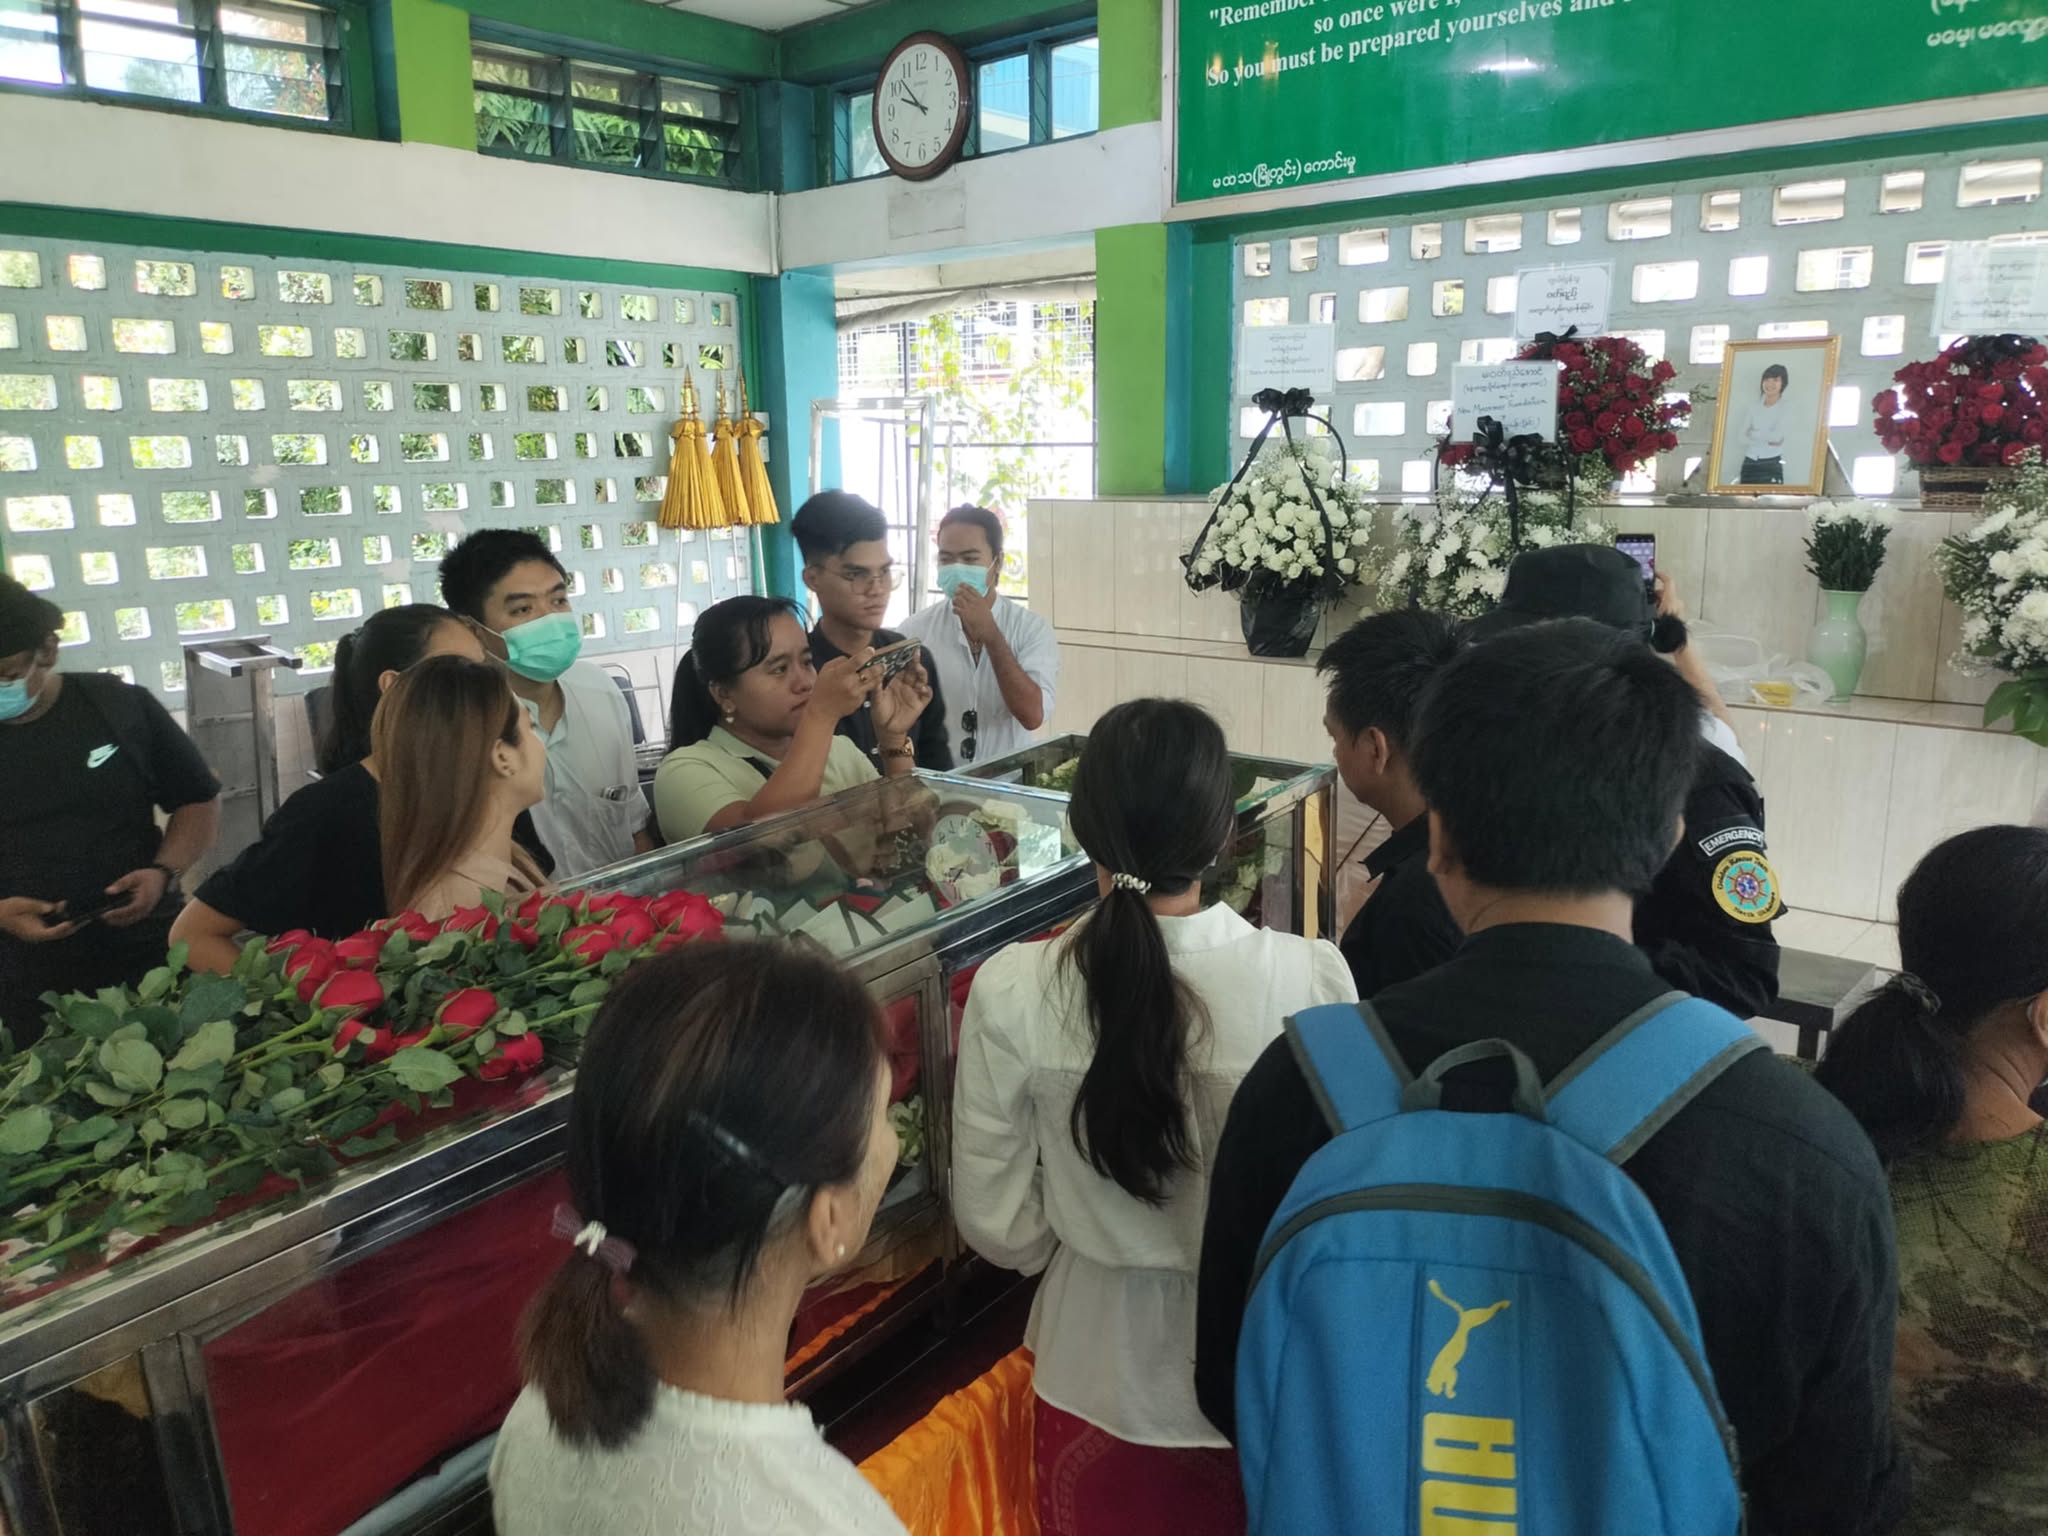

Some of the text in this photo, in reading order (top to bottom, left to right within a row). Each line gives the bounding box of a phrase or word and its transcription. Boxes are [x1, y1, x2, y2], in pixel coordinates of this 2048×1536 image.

[1314, 17, 1334, 34] so
[1339, 4, 1384, 29] once
[1390, 0, 1438, 17] were
[1208, 66, 1229, 87] So
[1233, 62, 1264, 87] you
[1271, 47, 1316, 73] must
[1321, 42, 1344, 63] be
[1349, 19, 1441, 63] prepared
[1446, 0, 1562, 43] yourselves
[916, 52, 927, 71] 12
[902, 62, 911, 79] 11
[945, 69, 952, 86] 2
[890, 80, 902, 97] 10
[949, 91, 956, 110] 3
[888, 104, 895, 122] 9
[944, 118, 952, 134] 4
[892, 128, 900, 144] 8
[934, 136, 941, 153] 5
[904, 142, 911, 158] 7
[919, 143, 926, 160] 6
[1703, 829, 1764, 852] EMERGENCY
